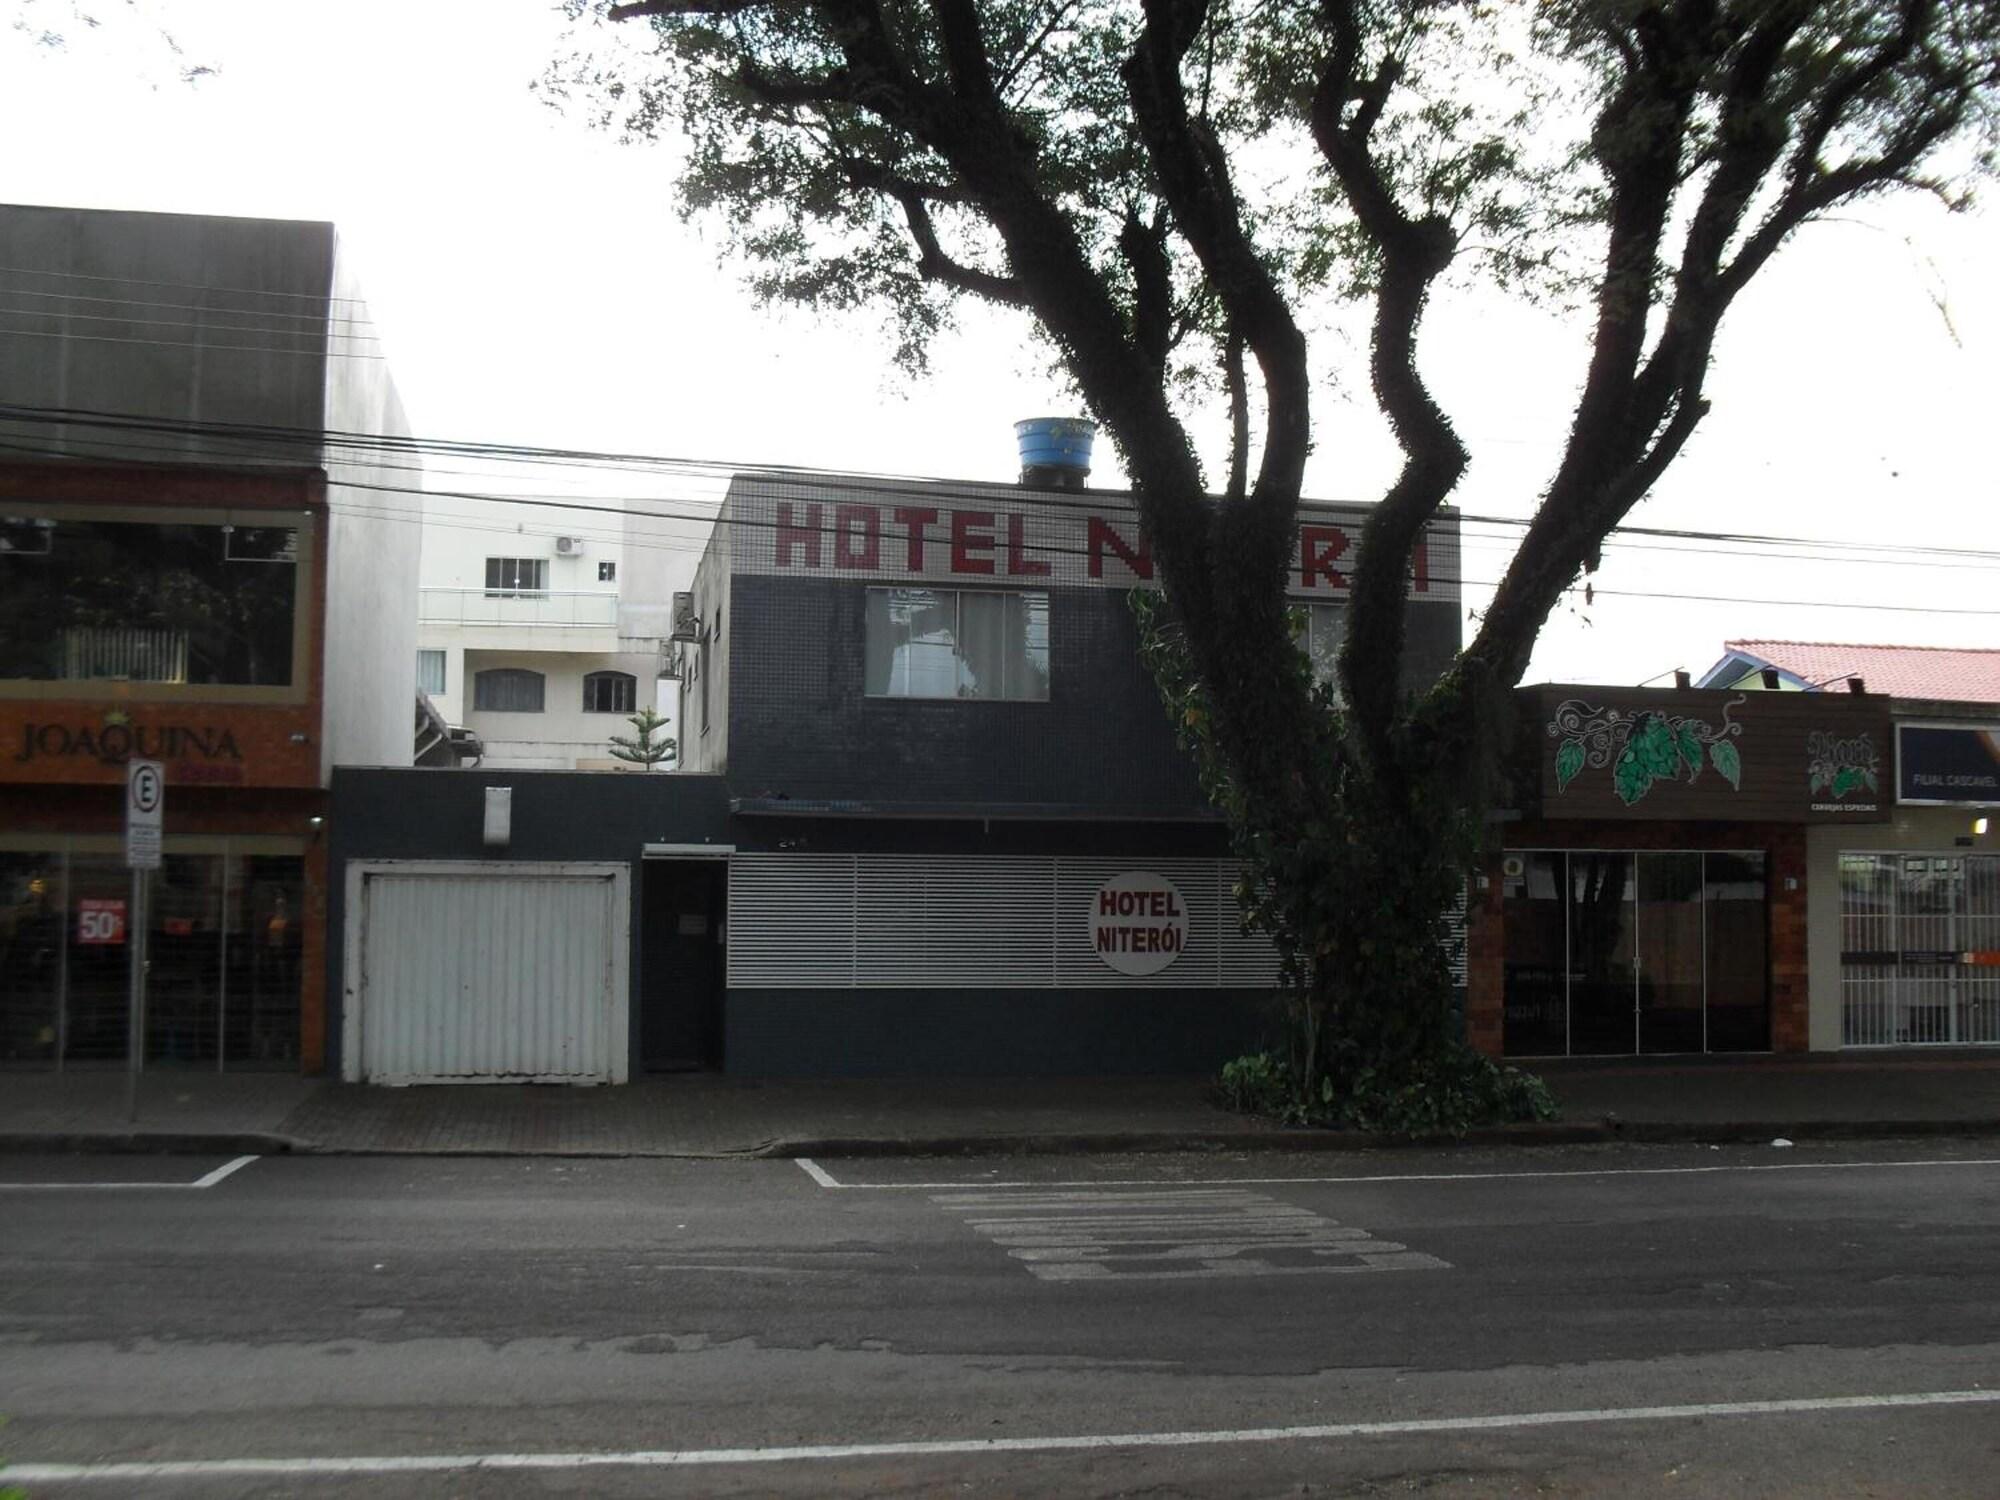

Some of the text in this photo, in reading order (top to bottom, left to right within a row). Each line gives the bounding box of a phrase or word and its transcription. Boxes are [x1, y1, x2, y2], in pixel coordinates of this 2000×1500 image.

[775, 502, 1051, 576] HOTEL
[16, 723, 242, 764] JOAQUINA
[142, 776, 152, 802] E
[1100, 890, 1180, 917] HOTEL
[1097, 921, 1182, 953] NITERÓI
